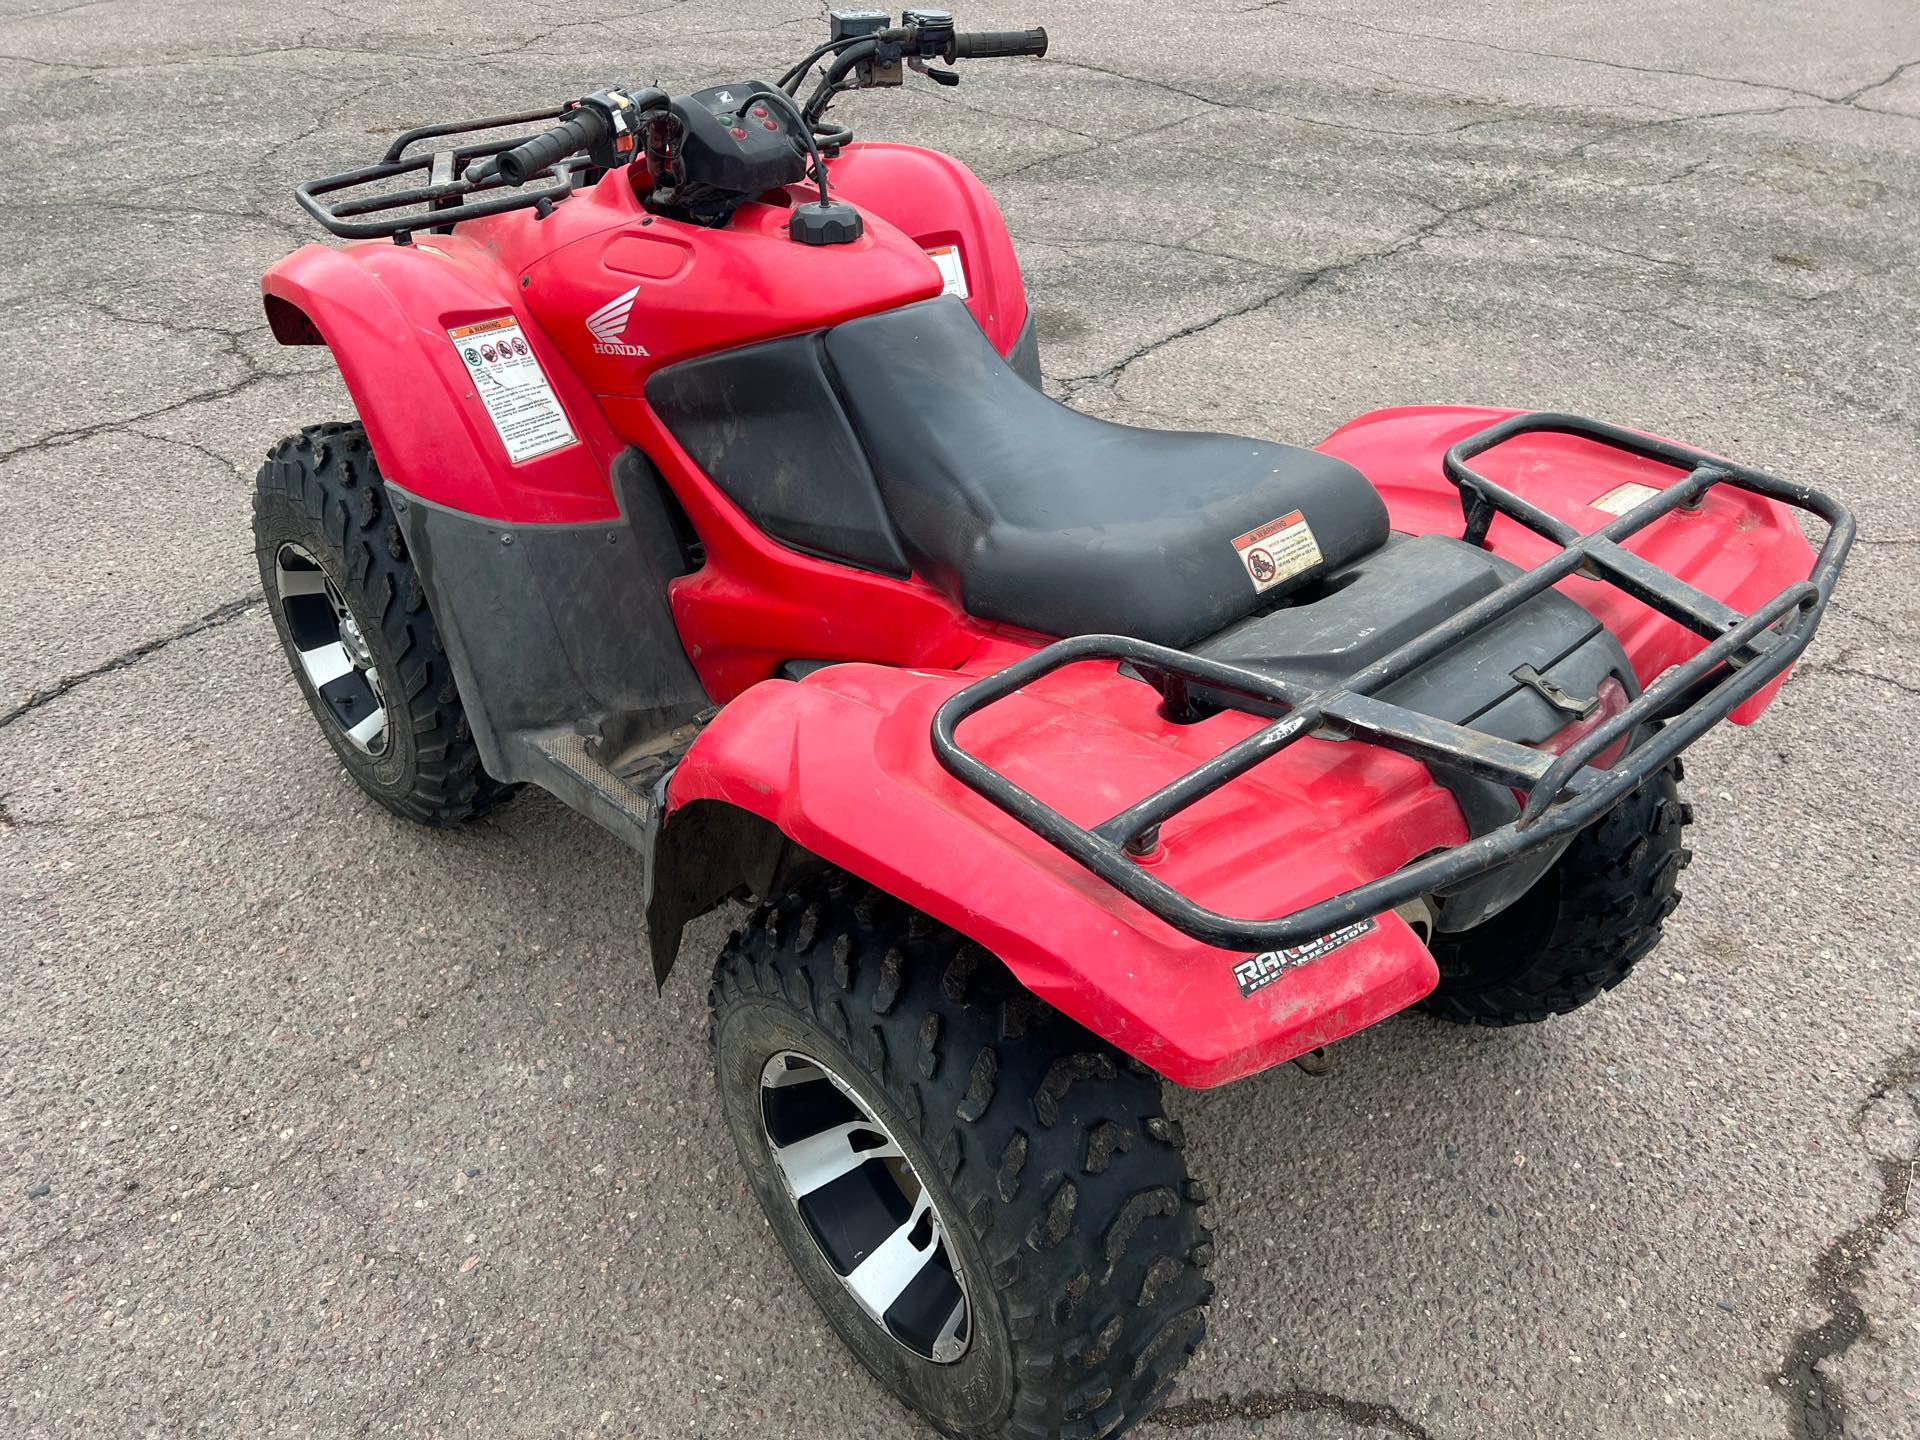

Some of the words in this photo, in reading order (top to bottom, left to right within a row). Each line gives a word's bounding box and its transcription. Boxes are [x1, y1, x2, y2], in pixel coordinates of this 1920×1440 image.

[474, 321, 501, 332] WARNING
[592, 343, 650, 357] HONDA
[1256, 520, 1287, 538] WARNING
